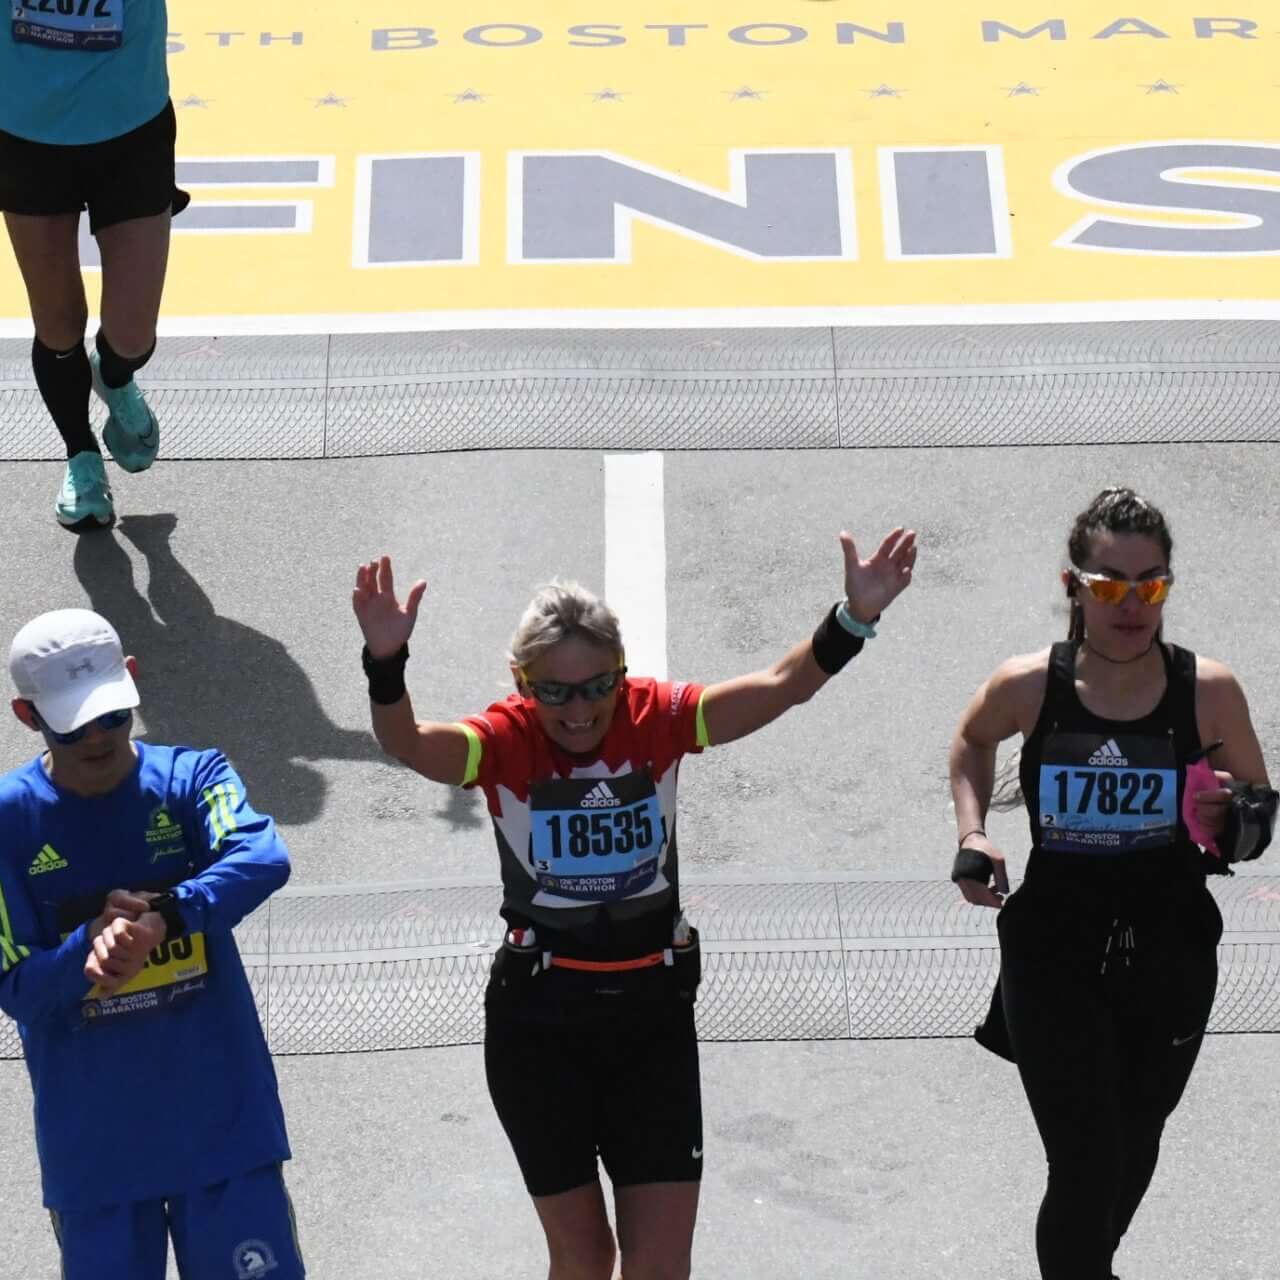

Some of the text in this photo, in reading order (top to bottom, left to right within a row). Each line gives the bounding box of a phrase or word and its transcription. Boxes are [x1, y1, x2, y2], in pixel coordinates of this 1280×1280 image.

[371, 22, 906, 51] BOSTON
[1088, 754, 1129, 767] adidas
[1054, 770, 1164, 816] 17822
[581, 799, 621, 809] adidas
[1044, 815, 1054, 825] 2
[546, 803, 653, 859] 18535
[29, 858, 69, 876] adidas
[538, 860, 549, 871] 3
[560, 883, 617, 892] MARATHON
[580, 877, 615, 886] BOSTON
[120, 991, 157, 1004] BOSTON
[102, 999, 159, 1016] MARATHON
